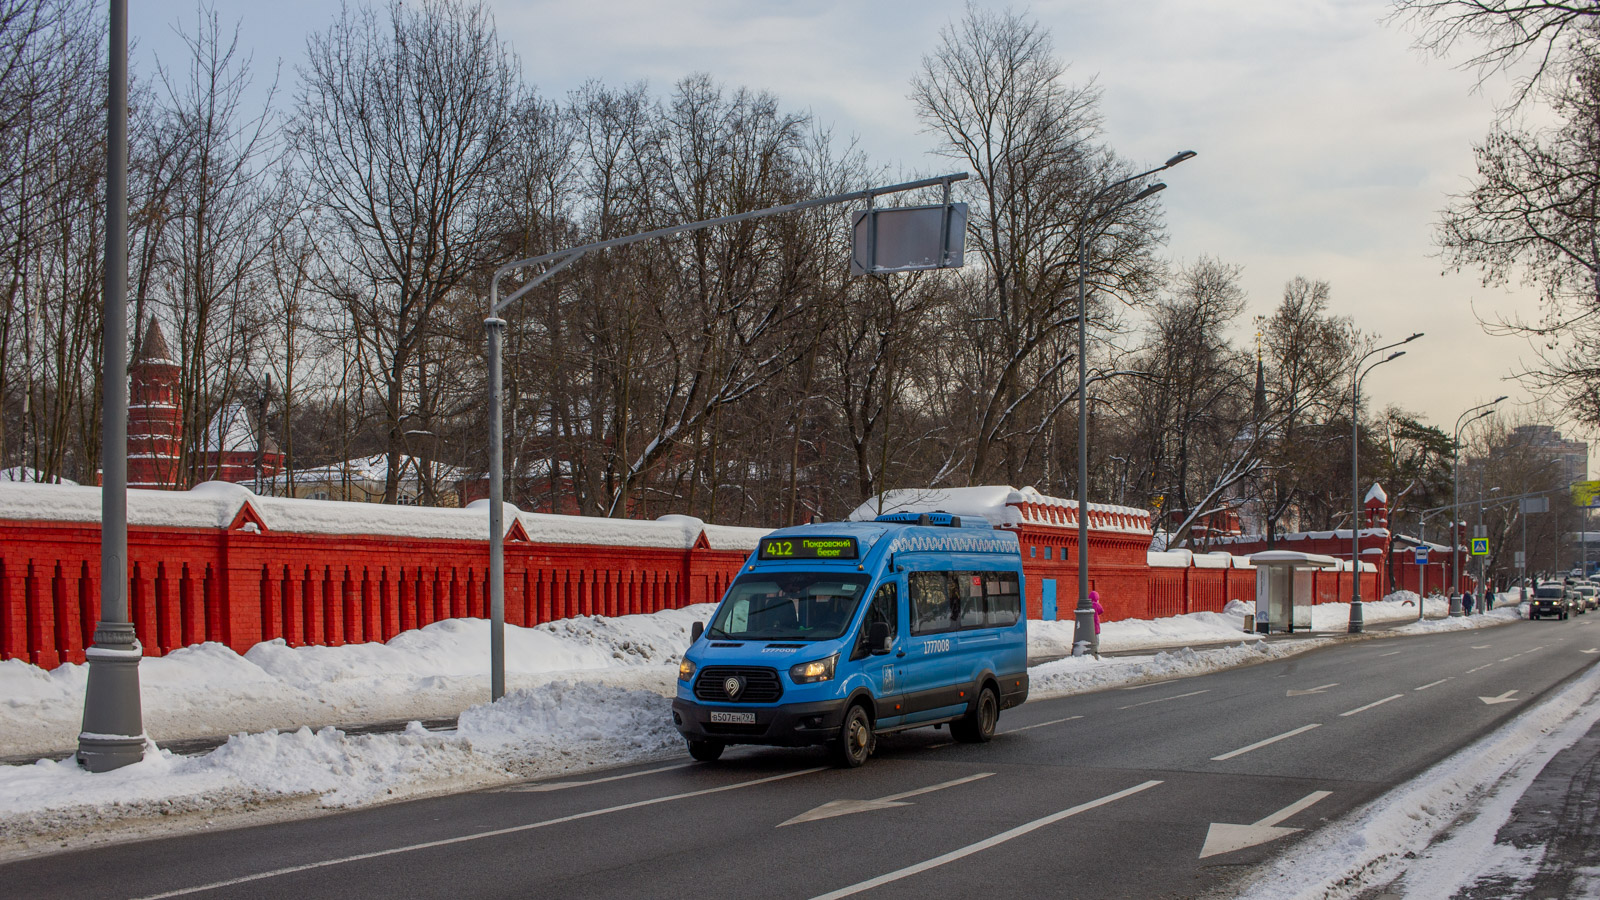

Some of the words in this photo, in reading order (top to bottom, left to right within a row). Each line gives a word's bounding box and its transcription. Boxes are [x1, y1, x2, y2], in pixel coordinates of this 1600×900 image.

[766, 541, 793, 556] 412
[802, 539, 851, 548] Покровский
[817, 547, 841, 557] берег
[923, 638, 950, 655] 1777008
